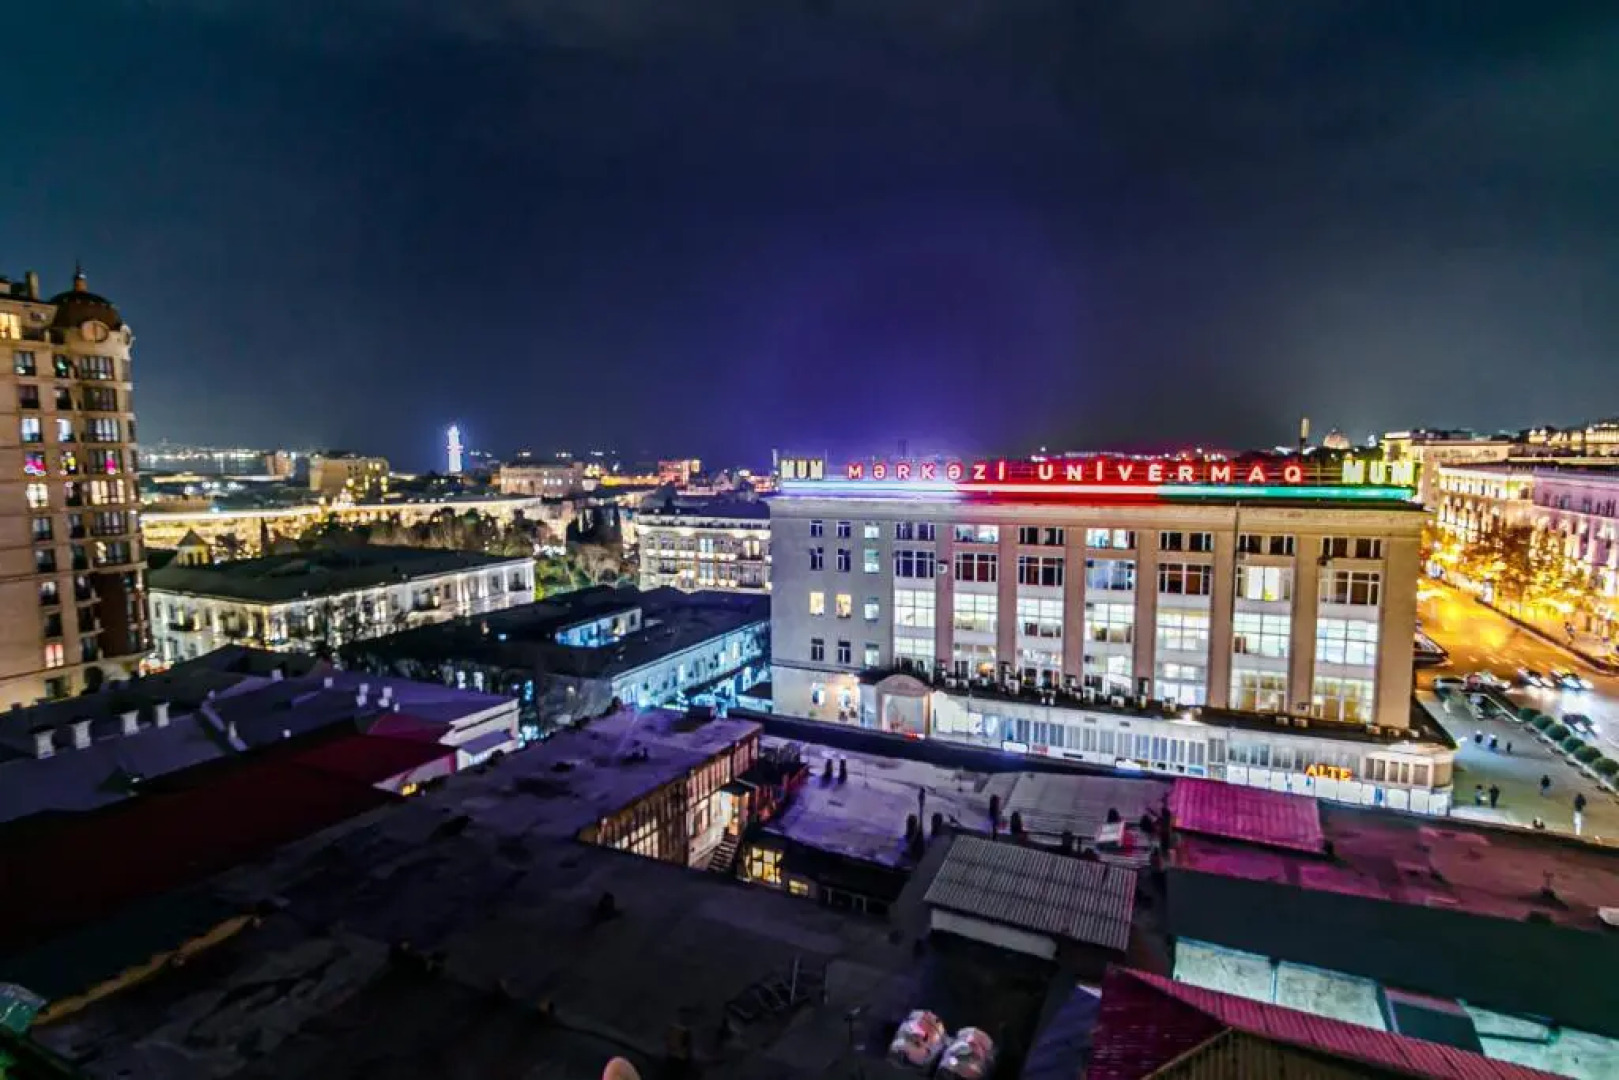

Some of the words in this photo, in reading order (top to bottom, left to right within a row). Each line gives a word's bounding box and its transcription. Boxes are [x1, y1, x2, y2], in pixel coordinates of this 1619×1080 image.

[780, 459, 824, 480] MUM
[848, 461, 1004, 480] MƏRKƏZİ
[1038, 461, 1302, 482] UNİVERMAQ
[1342, 460, 1413, 484] MUM
